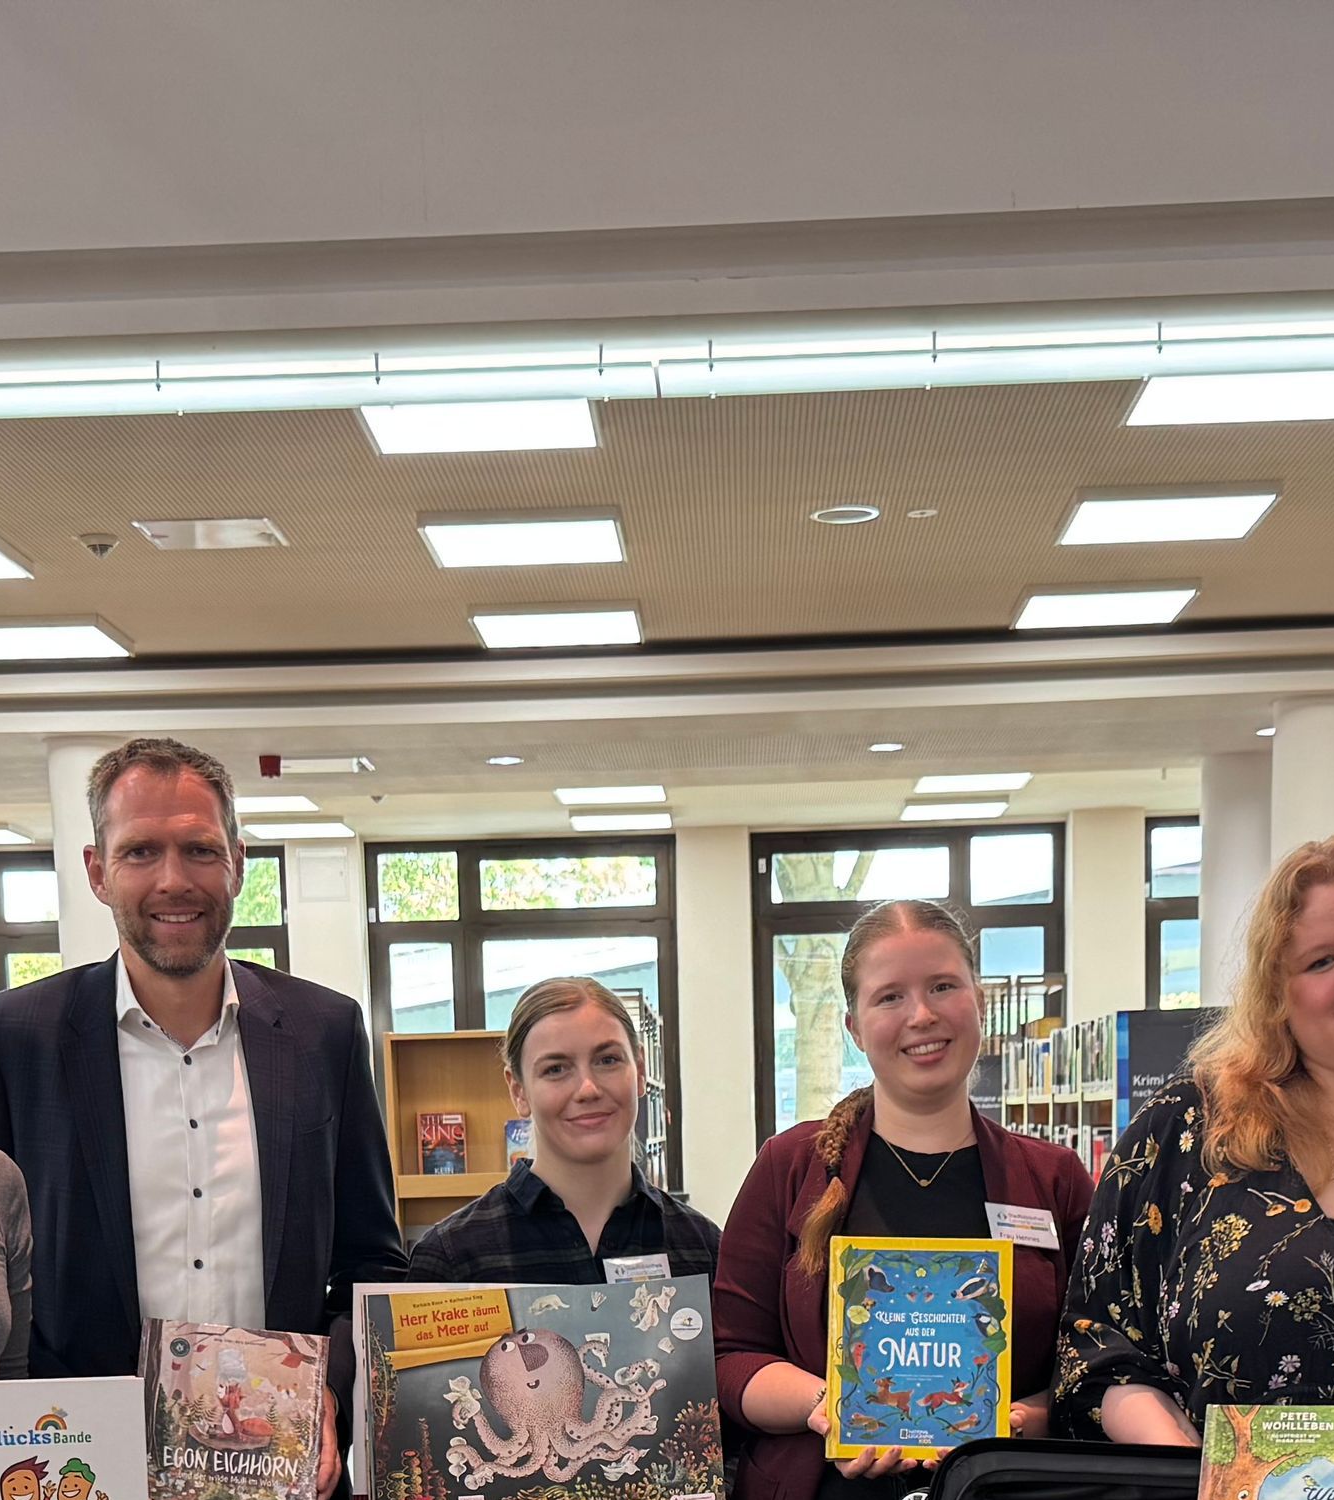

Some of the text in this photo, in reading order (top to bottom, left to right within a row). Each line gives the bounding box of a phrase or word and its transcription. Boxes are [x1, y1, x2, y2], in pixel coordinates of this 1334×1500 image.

[1133, 1075, 1165, 1087] Krimi
[421, 1125, 464, 1140] KING
[400, 1305, 500, 1327] Herr Krake räumt
[875, 1311, 966, 1324] KLEINE GESCHICHTEN
[416, 1322, 489, 1341] das Meer auf
[905, 1328, 936, 1337] AUS DER
[878, 1337, 961, 1372] NATUR
[1280, 1412, 1317, 1421] PETER
[1262, 1422, 1334, 1431] WOHLLEBEN
[164, 1446, 298, 1479] EGON EICHHORN
